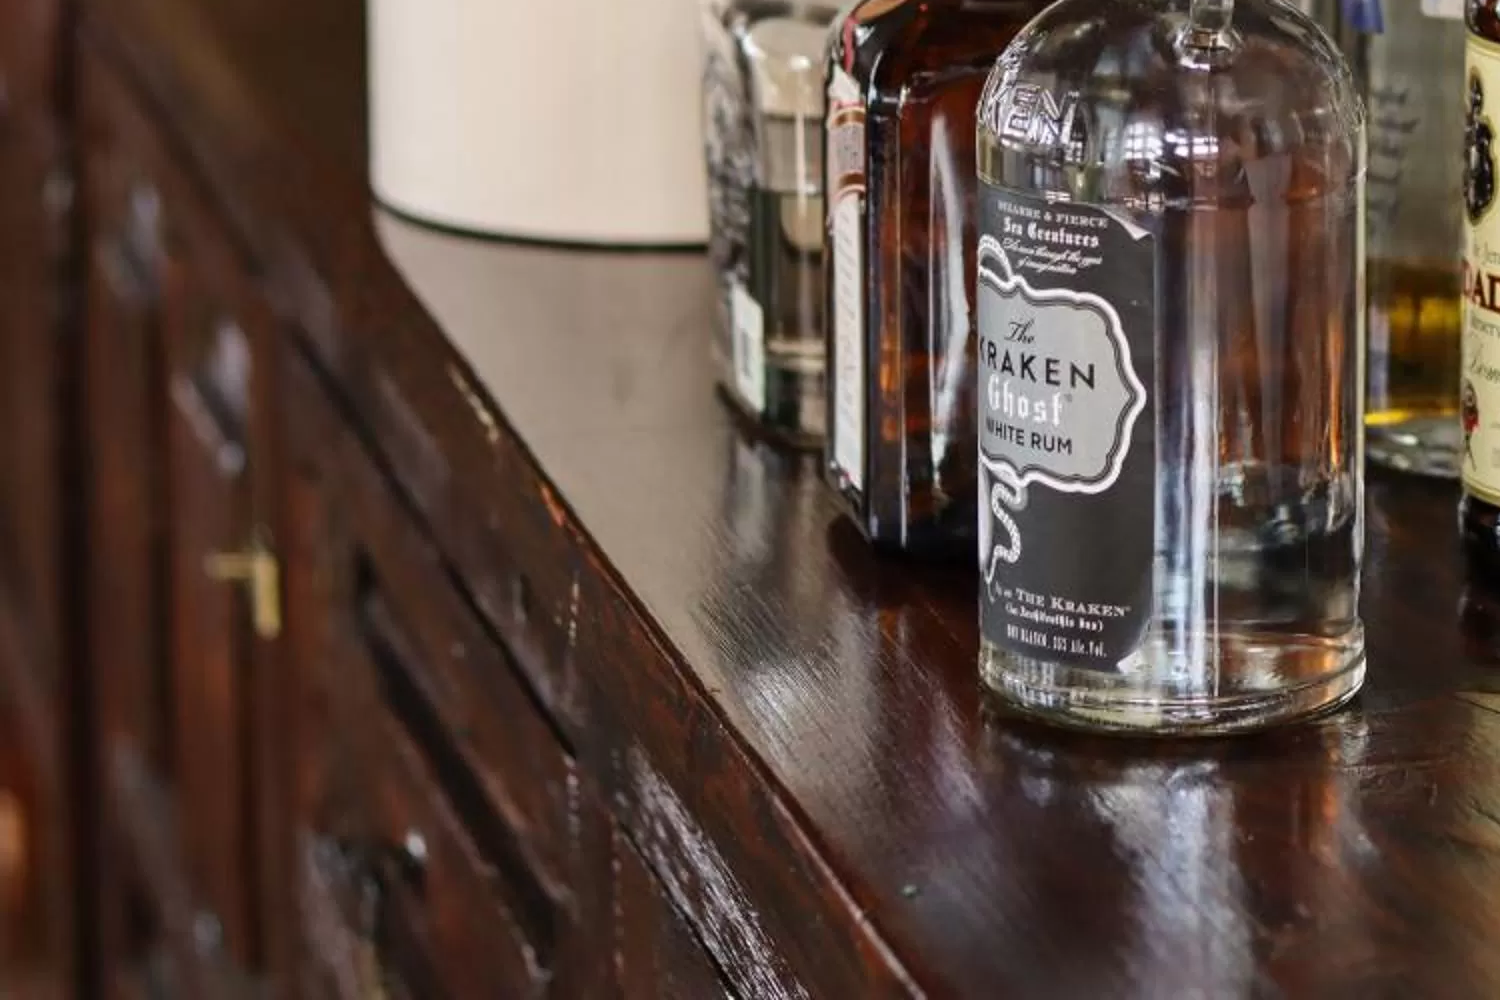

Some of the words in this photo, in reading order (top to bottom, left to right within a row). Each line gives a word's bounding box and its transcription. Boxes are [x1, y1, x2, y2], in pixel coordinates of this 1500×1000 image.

[1004, 319, 1035, 344] The
[988, 374, 1063, 426] Ghost
[986, 416, 1025, 447] WHITE
[1031, 431, 1073, 456] RUM
[1016, 587, 1045, 607] THE
[1051, 597, 1125, 617] KRAKEN
